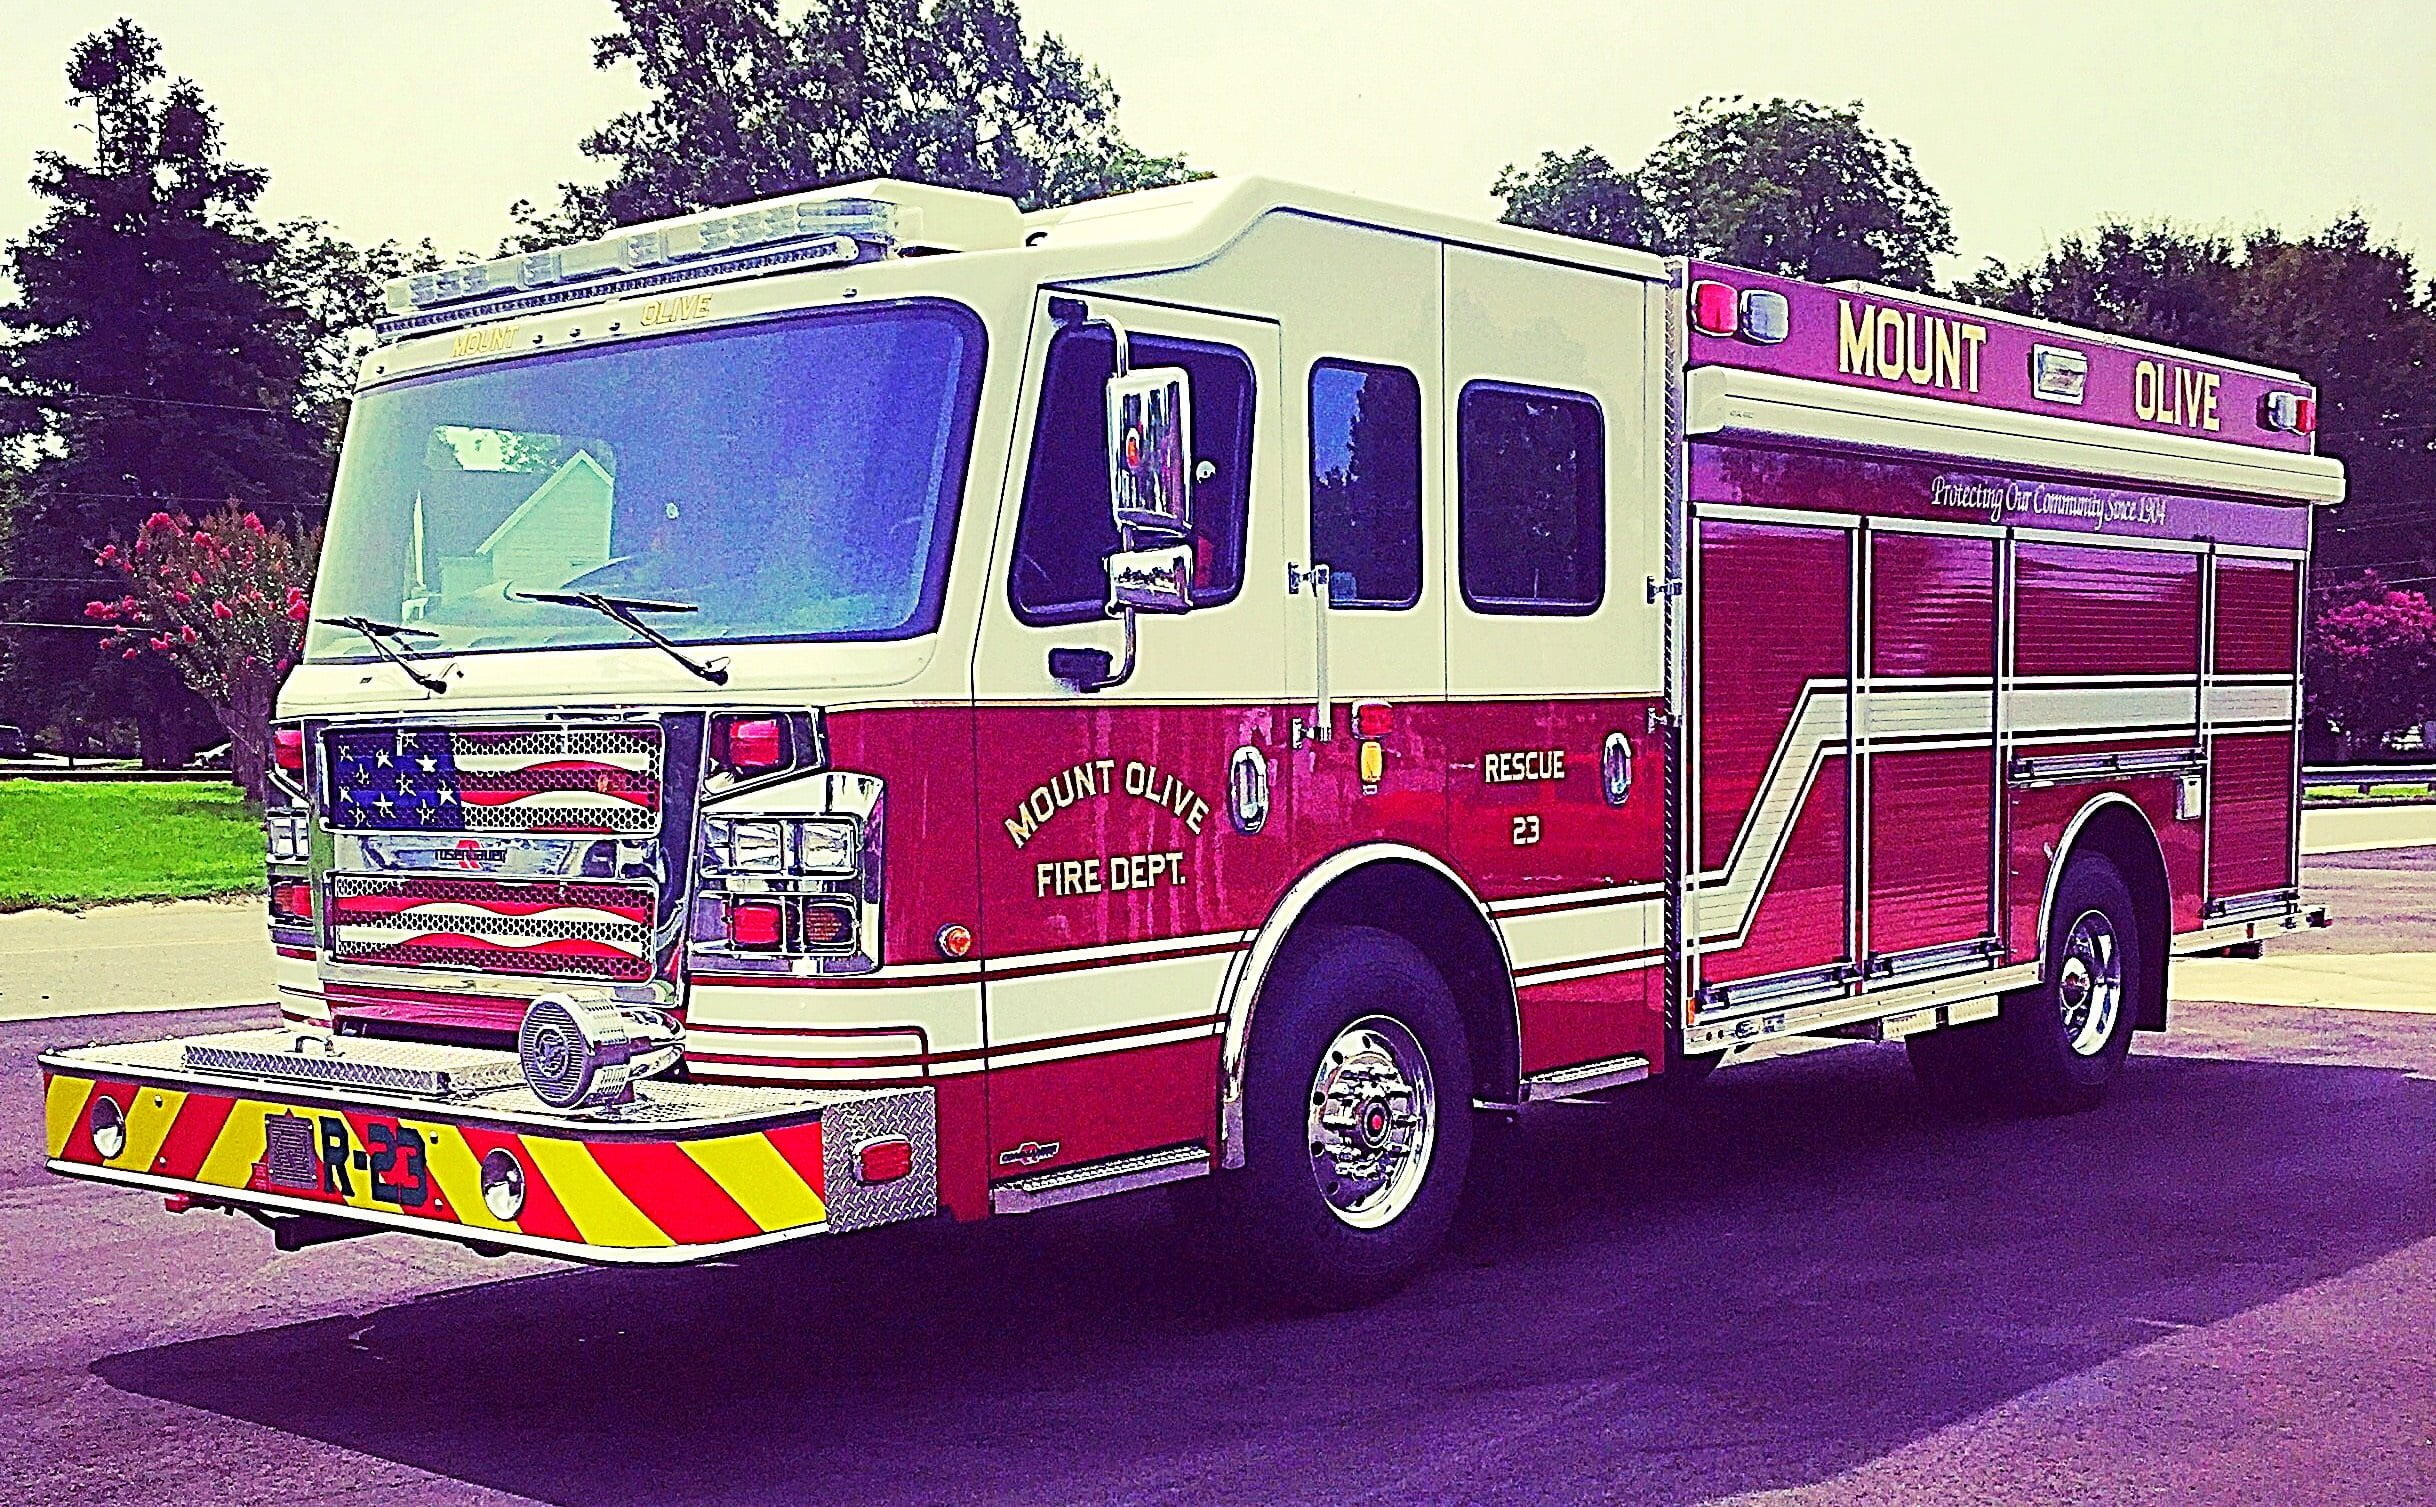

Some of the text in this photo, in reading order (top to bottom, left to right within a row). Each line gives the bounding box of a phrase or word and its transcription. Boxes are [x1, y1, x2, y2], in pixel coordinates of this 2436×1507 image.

[453, 294, 712, 356] MOUNT OLIVE
[1838, 299, 2221, 432] MOUNT OLIVE
[1931, 475, 2167, 531] Protecting Our Community Since 1904
[1485, 750, 1565, 783] RESCUE
[1004, 759, 1210, 848] MOUNT OLIVE
[1513, 815, 1540, 845] 23
[1037, 852, 1186, 897] FIRE DEPT.
[318, 1115, 428, 1208] R-23
